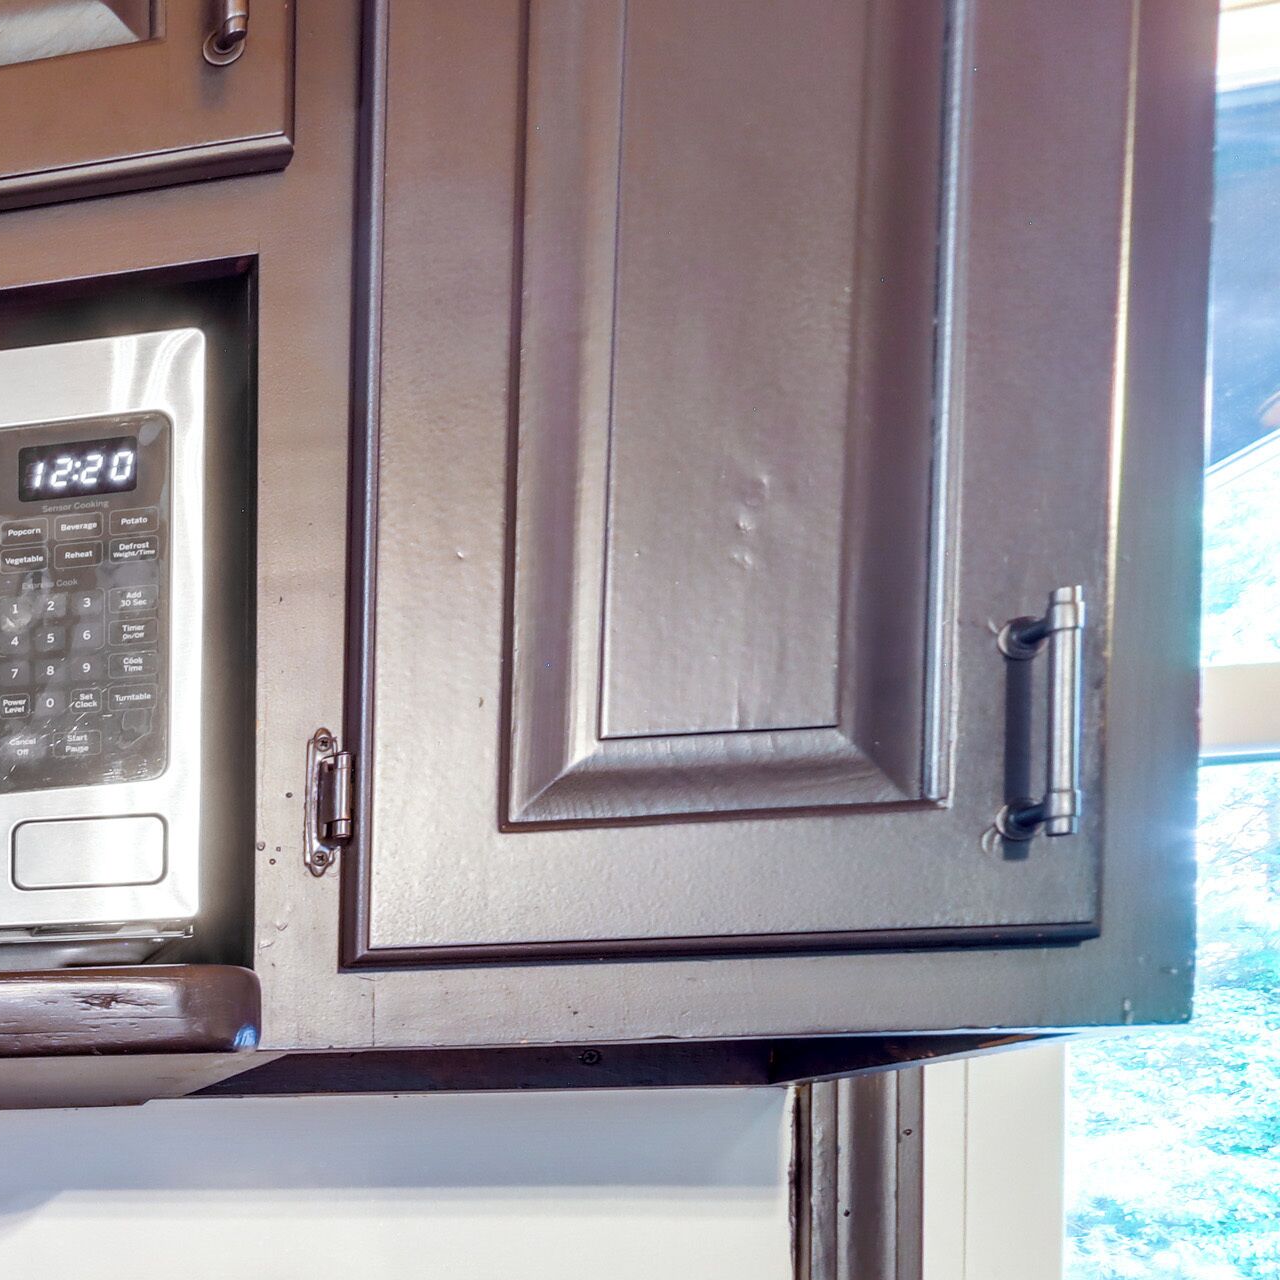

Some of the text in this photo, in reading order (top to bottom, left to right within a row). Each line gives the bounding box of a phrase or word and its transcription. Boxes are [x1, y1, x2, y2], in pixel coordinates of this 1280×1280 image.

[33, 451, 134, 488] 12:20
[42, 500, 110, 513] Sensor Cooking
[121, 516, 148, 525] Potato
[60, 521, 97, 532] Beverage
[8, 528, 41, 537] Popcorn
[119, 541, 149, 550] Defrost
[65, 550, 93, 559] Reheat
[113, 549, 155, 558] Weight/Time
[5, 555, 43, 566] Vegetable
[56, 578, 78, 588] Cook
[126, 591, 141, 599] Add
[47, 601, 55, 611] 2
[83, 597, 91, 608] 3
[12, 604, 18, 614] 1
[122, 624, 144, 632] Timer
[47, 633, 55, 643] 5
[82, 630, 91, 640] 6
[11, 636, 19, 646] 4
[123, 657, 143, 665] Cook
[46, 666, 54, 676] 8
[82, 662, 91, 672] 9
[123, 664, 143, 672] Time
[11, 668, 19, 679] 7
[114, 692, 151, 701] Turntable
[46, 698, 54, 708] 0
[75, 700, 97, 708] Clock
[4, 706, 25, 714] Level
[9, 738, 36, 746] Cancel
[67, 733, 88, 742] Start
[17, 748, 29, 756] Off
[65, 745, 89, 753] Pause
